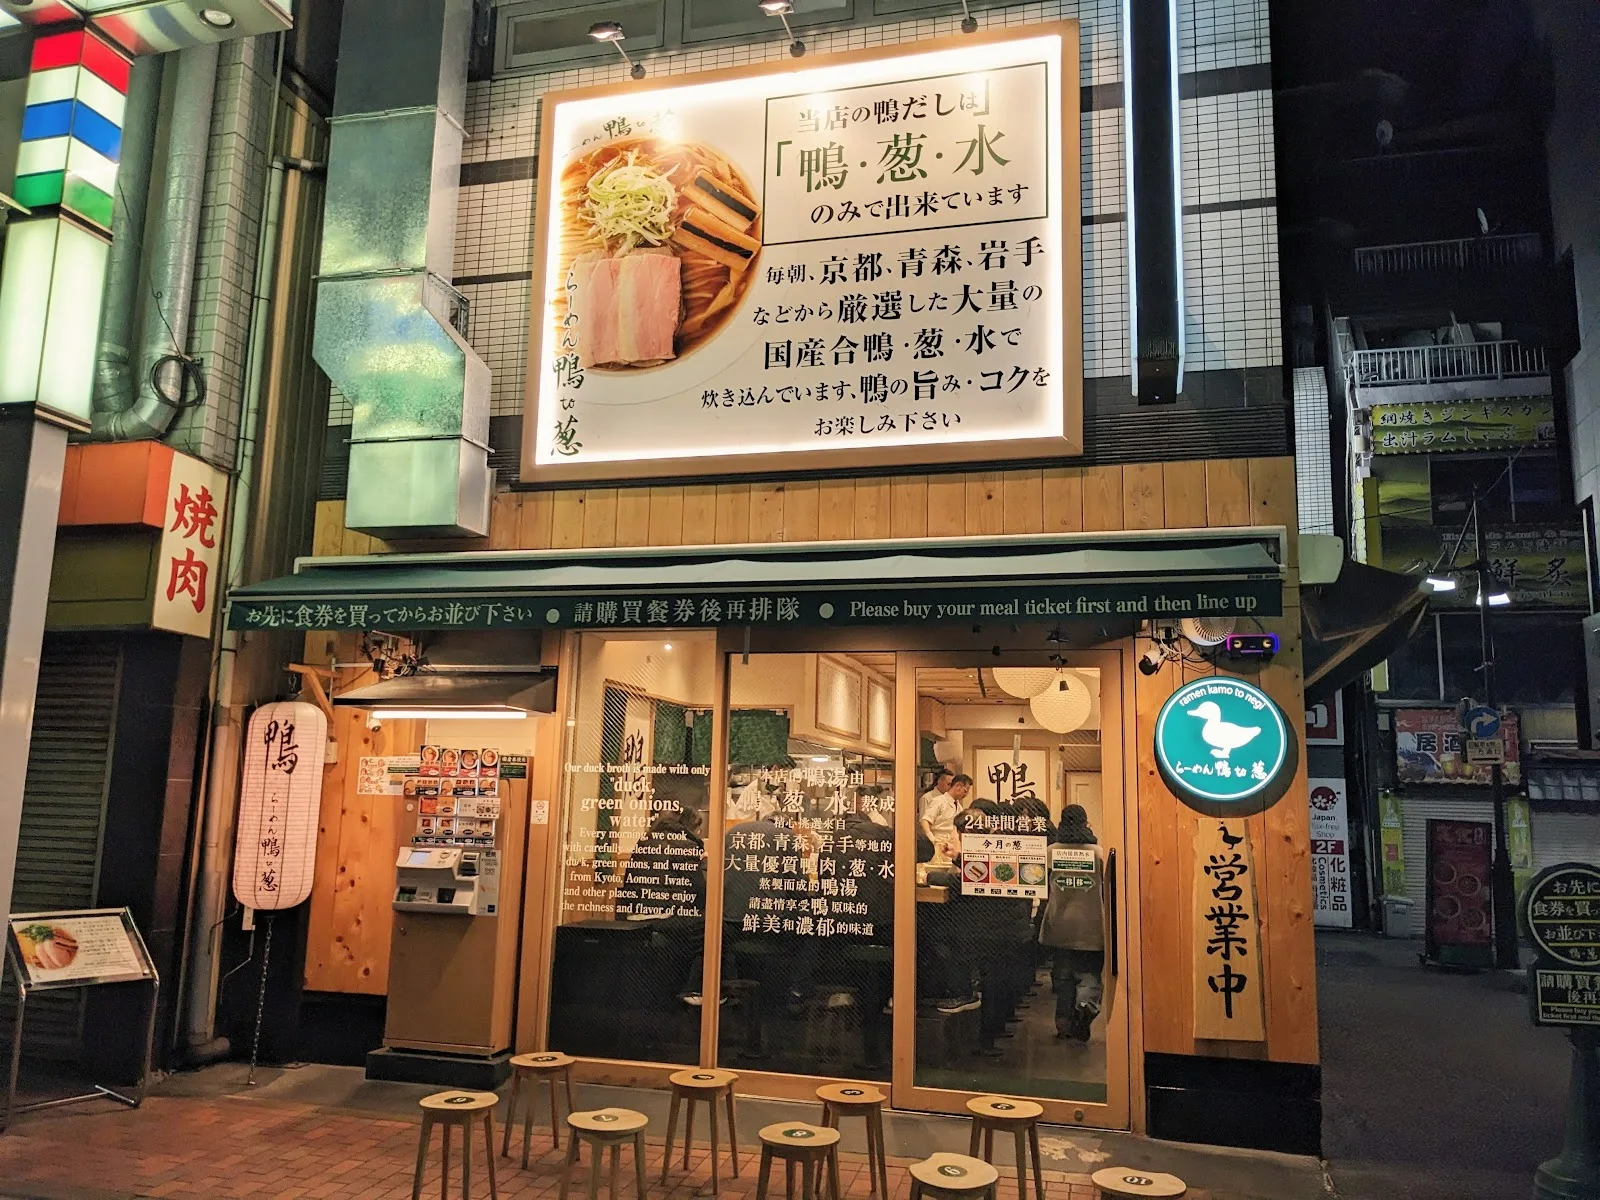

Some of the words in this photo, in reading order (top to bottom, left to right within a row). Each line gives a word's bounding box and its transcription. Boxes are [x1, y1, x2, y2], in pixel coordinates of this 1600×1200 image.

[810, 183, 1030, 225] のみで出来ています
[766, 235, 1046, 286] 毎朝、京都、青森、岩手
[752, 279, 1044, 327] などから厳選した大量の
[763, 323, 1023, 370] 国産合鴨・葱・水で
[700, 364, 1052, 410] 炊き込んでいます、鴨の旨み・コクを
[813, 410, 963, 437] お楽しみ下さい
[166, 483, 218, 614] 焼肉
[245, 603, 533, 628] お先に食券を買ってからお並び下さい
[573, 597, 801, 624] 請購買餐券後再排隊
[850, 600, 900, 617] Please
[903, 600, 932, 619] buy
[936, 603, 976, 619] your
[979, 598, 1020, 615] meal
[1024, 598, 1072, 615] ticket
[1076, 596, 1111, 614] first
[1116, 595, 1148, 613] and
[1153, 594, 1197, 612] then
[1196, 593, 1229, 610] line
[1235, 595, 1258, 612] up
[1179, 687, 1207, 707] ramen
[1207, 684, 1233, 696] kamo
[1234, 687, 1245, 699] to
[1244, 693, 1266, 711] negi
[264, 719, 299, 775] 鴨
[564, 762, 581, 773] Our
[583, 763, 605, 773] duck
[606, 763, 631, 774] broth
[632, 763, 641, 774] is
[642, 764, 667, 775] made
[669, 764, 689, 775] with
[690, 764, 711, 777] only
[609, 776, 656, 795] "duck,
[580, 798, 624, 812] green
[628, 794, 684, 814] onions,
[609, 812, 660, 828] water"
[964, 814, 1048, 832] 24時間営業
[580, 827, 609, 839] Every
[608, 829, 649, 841] morning,
[651, 832, 665, 841] we
[666, 830, 688, 841] cook
[729, 831, 893, 854] 京都、青森、岩手等地的
[562, 841, 582, 853] with
[584, 842, 624, 855] carefully
[627, 844, 662, 855] elected
[663, 846, 705, 857] domestic
[982, 839, 1022, 851] 今月の葱
[1315, 841, 1337, 854] 2F
[565, 857, 590, 868] duck,
[592, 860, 618, 870] green
[619, 859, 651, 870] onions,
[652, 860, 669, 871] and
[671, 862, 699, 872] water
[569, 871, 592, 882] from
[593, 872, 624, 885] Kyoto,
[664, 874, 693, 887] Iwate,
[1318, 856, 1329, 911] Cosmetics
[1330, 857, 1348, 912] 化粧品
[1553, 879, 1600, 895] お先に
[563, 885, 580, 897] and
[582, 886, 606, 898] other
[608, 888, 639, 902] places.
[641, 888, 670, 901] Please
[671, 891, 697, 904] enjoy
[562, 901, 575, 911] the
[576, 902, 615, 913] richness
[616, 902, 633, 914] and
[635, 903, 664, 916] flavor
[665, 904, 676, 916] of
[676, 906, 702, 918] duck.
[1532, 900, 1600, 917] 食券を買っ
[742, 913, 874, 938] 鮮美和濃郁的味道
[1544, 924, 1600, 941] お並び下
[1203, 853, 1250, 1019] 営業中
[1567, 989, 1600, 1005] 後再
[1125, 1176, 1148, 1186] 10
